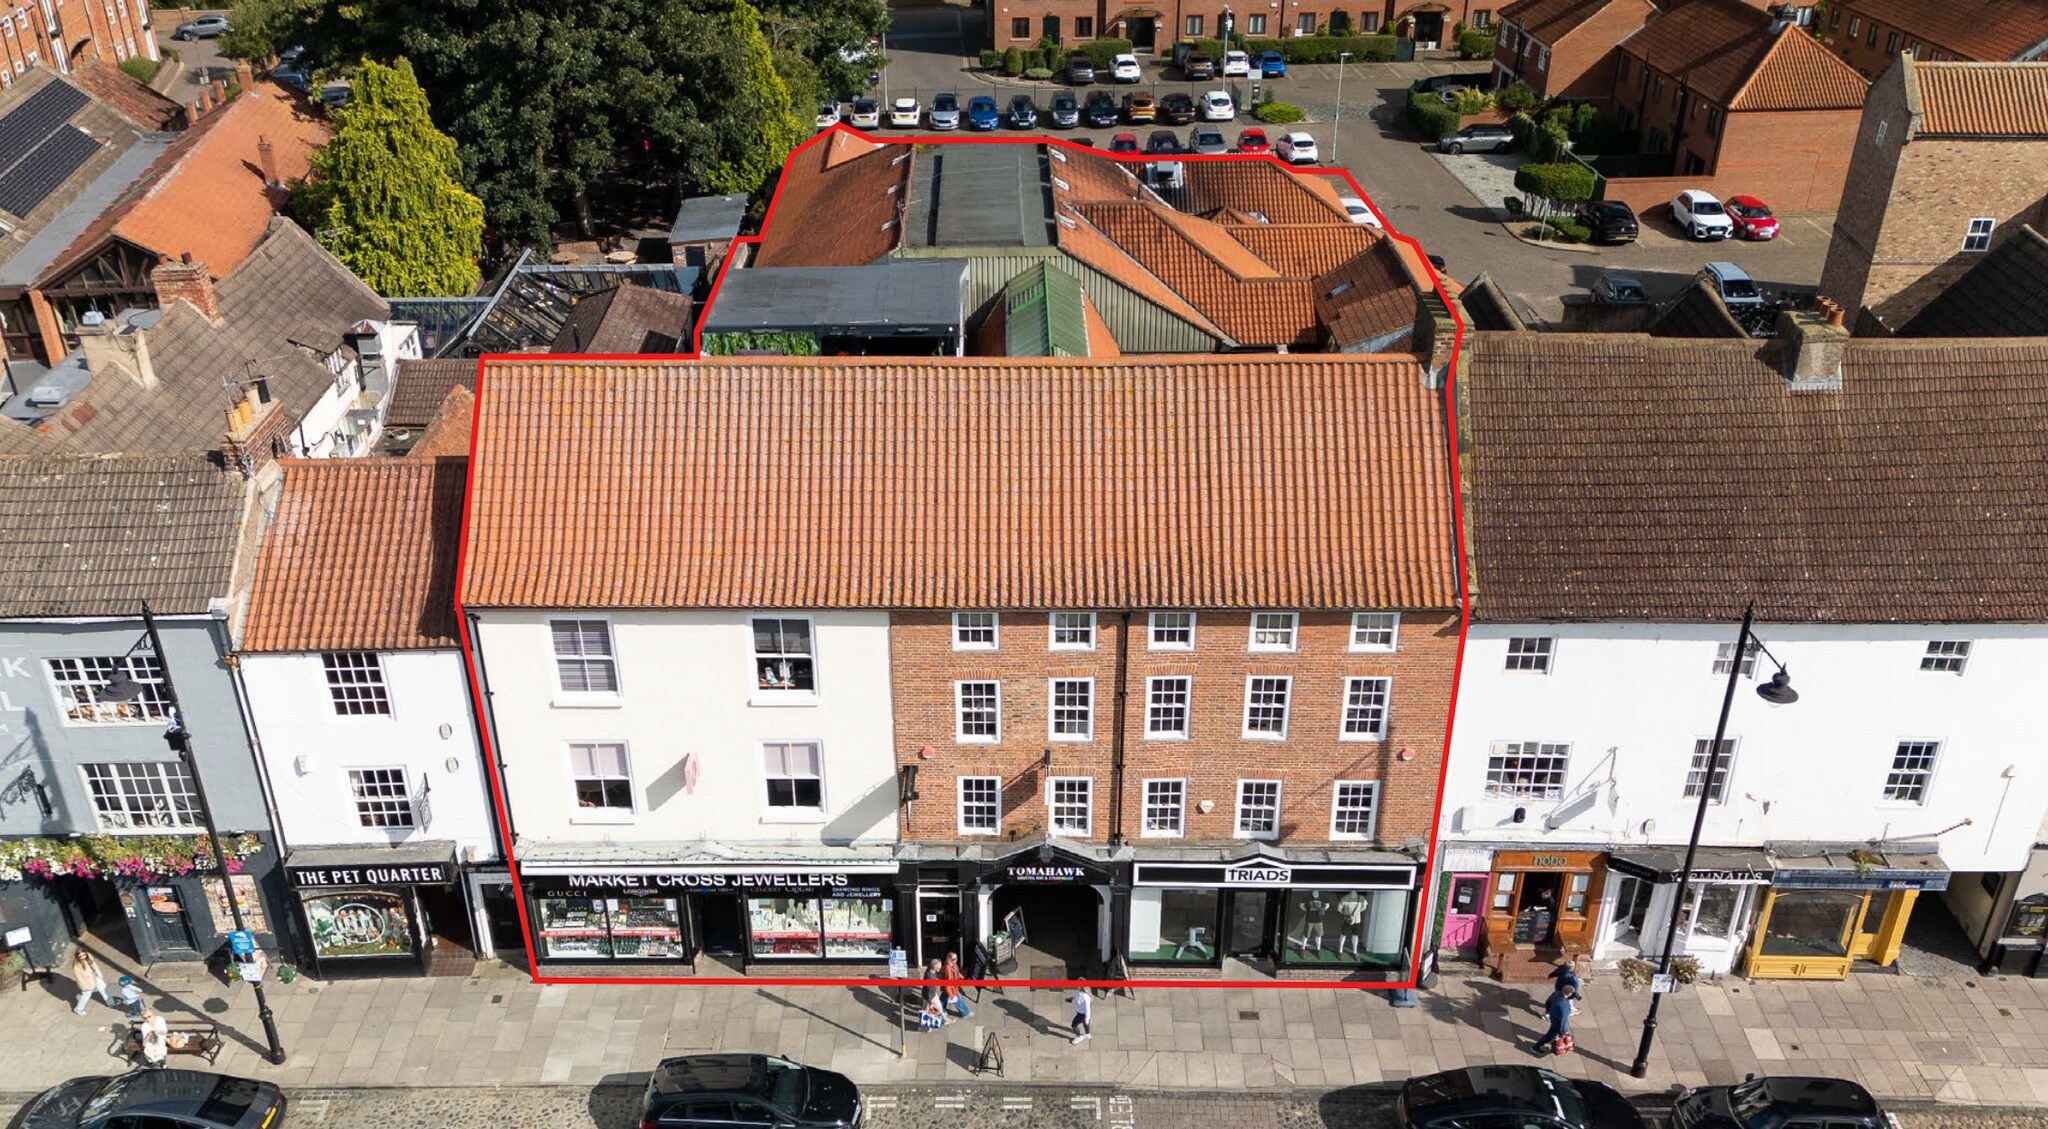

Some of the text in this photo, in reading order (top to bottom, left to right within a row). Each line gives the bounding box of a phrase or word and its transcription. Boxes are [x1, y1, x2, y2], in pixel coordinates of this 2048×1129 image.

[0, 656, 32, 678] K
[0, 691, 26, 712] L
[296, 867, 443, 885] THE PET QUARTER
[1006, 866, 1085, 876] TOMAHAWK
[1228, 869, 1289, 881] TRIADS
[568, 874, 848, 887] MARKET CROSS JEWELLERS
